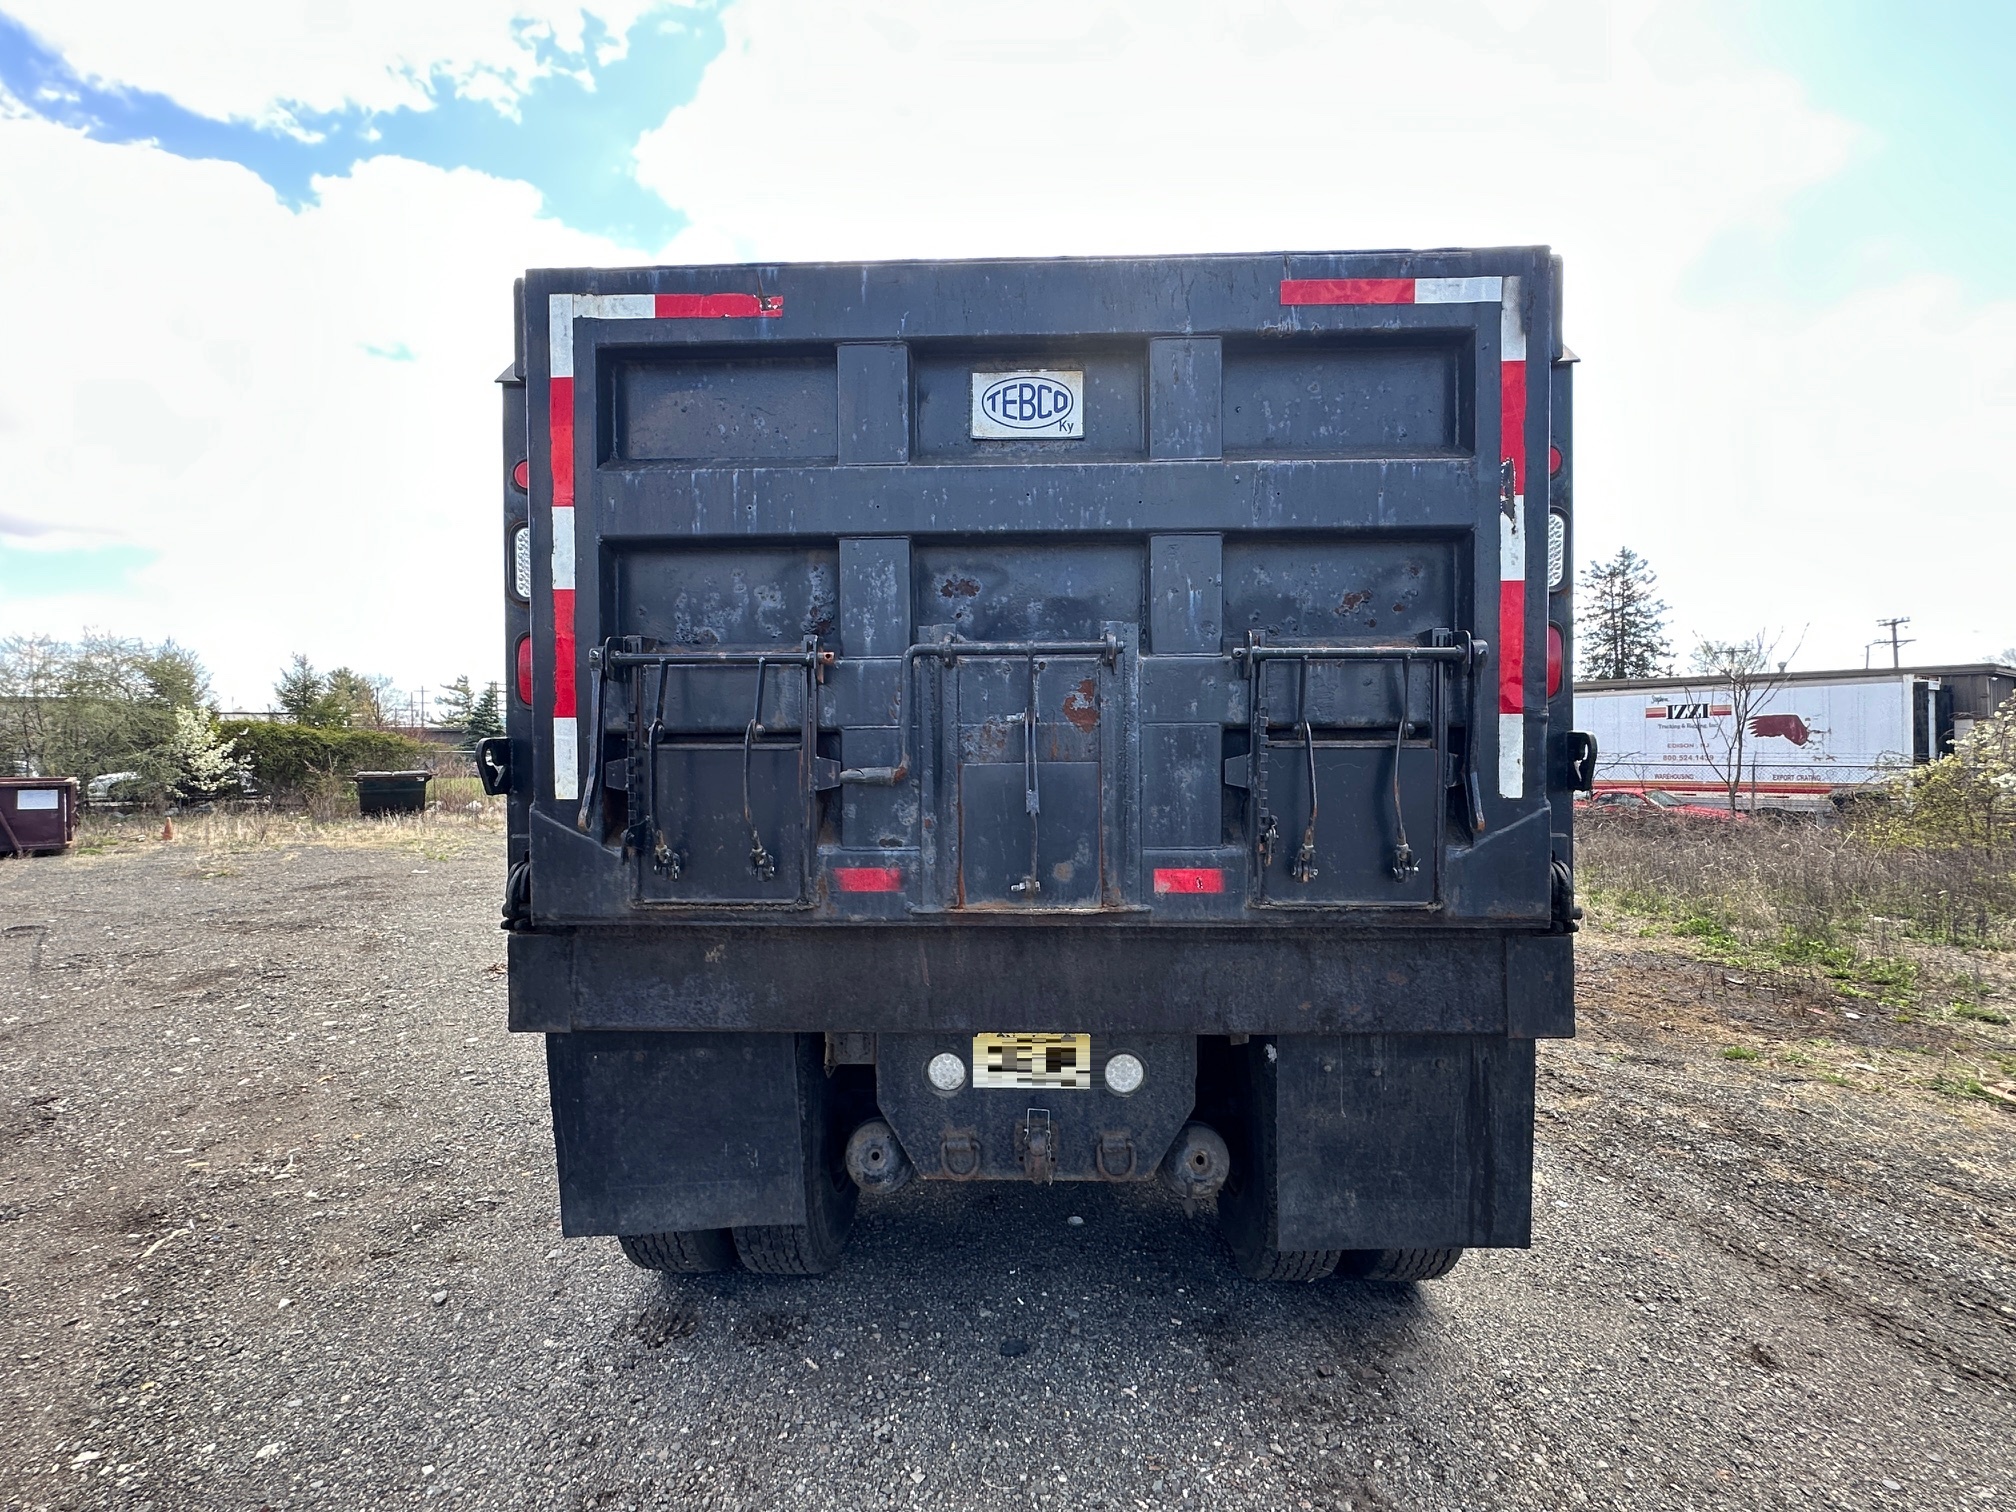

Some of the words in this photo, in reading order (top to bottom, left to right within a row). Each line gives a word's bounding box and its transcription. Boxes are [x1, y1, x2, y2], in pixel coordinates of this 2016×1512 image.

[987, 383, 1068, 421] TEBCO
[1059, 420, 1074, 434] Ky
[1666, 703, 1709, 719] IZZI
